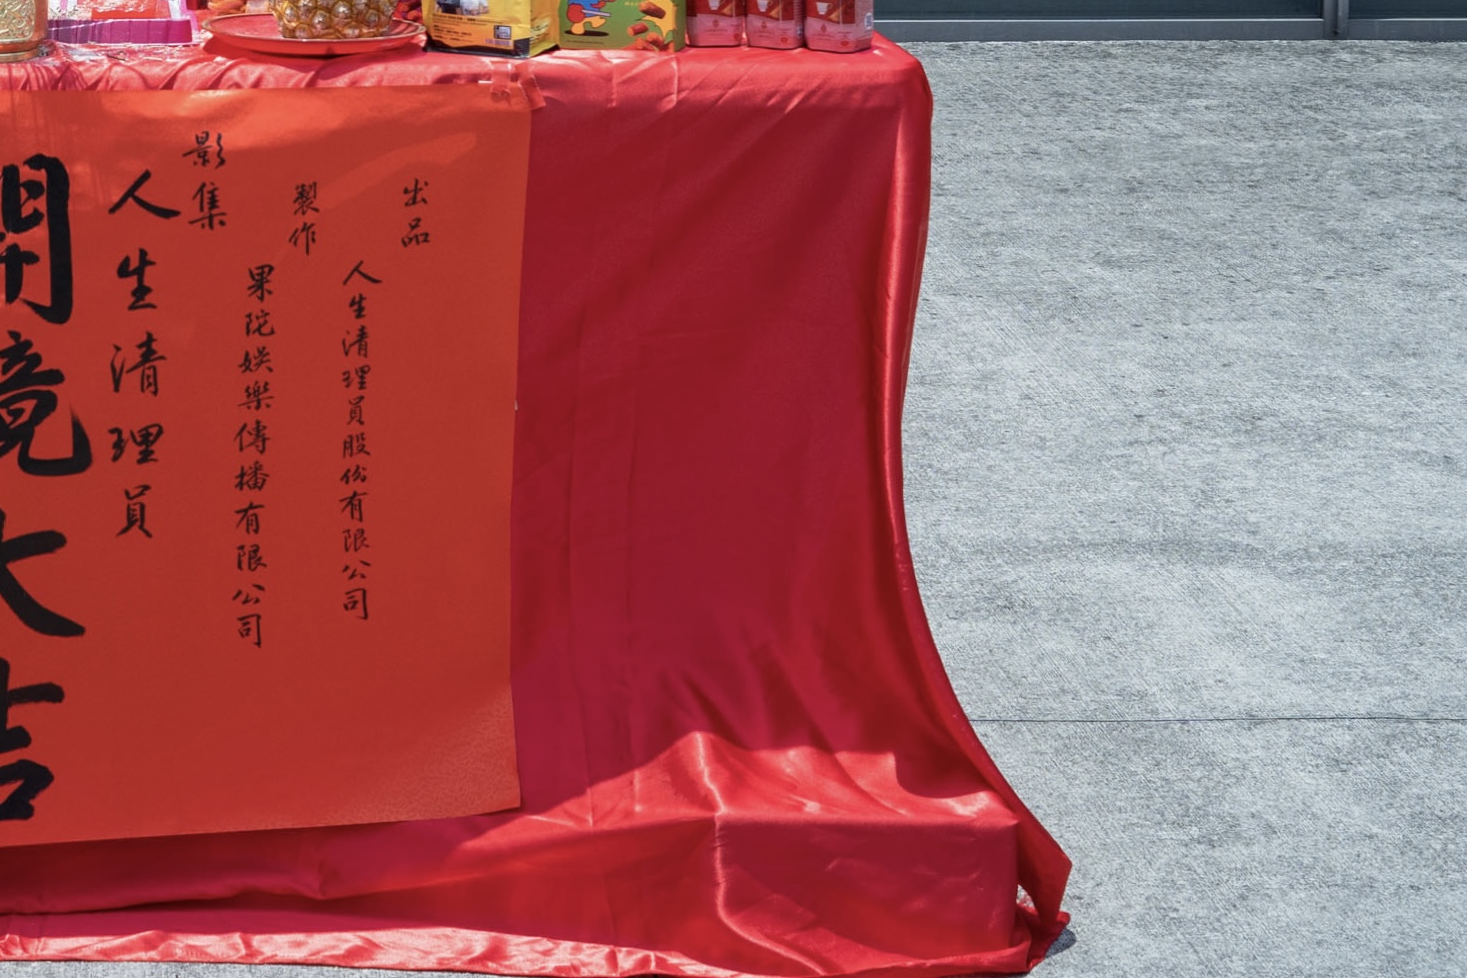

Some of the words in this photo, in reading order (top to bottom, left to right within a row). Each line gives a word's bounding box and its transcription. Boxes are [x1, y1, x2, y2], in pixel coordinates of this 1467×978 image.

[181, 130, 228, 231] 影集
[288, 180, 320, 257] 製作
[400, 177, 431, 249] 出品
[108, 169, 181, 538] 人生清理員
[231, 263, 276, 649] 果陀娛樂傳播有限公司
[339, 259, 383, 621] 人生清理員股份有限公司
